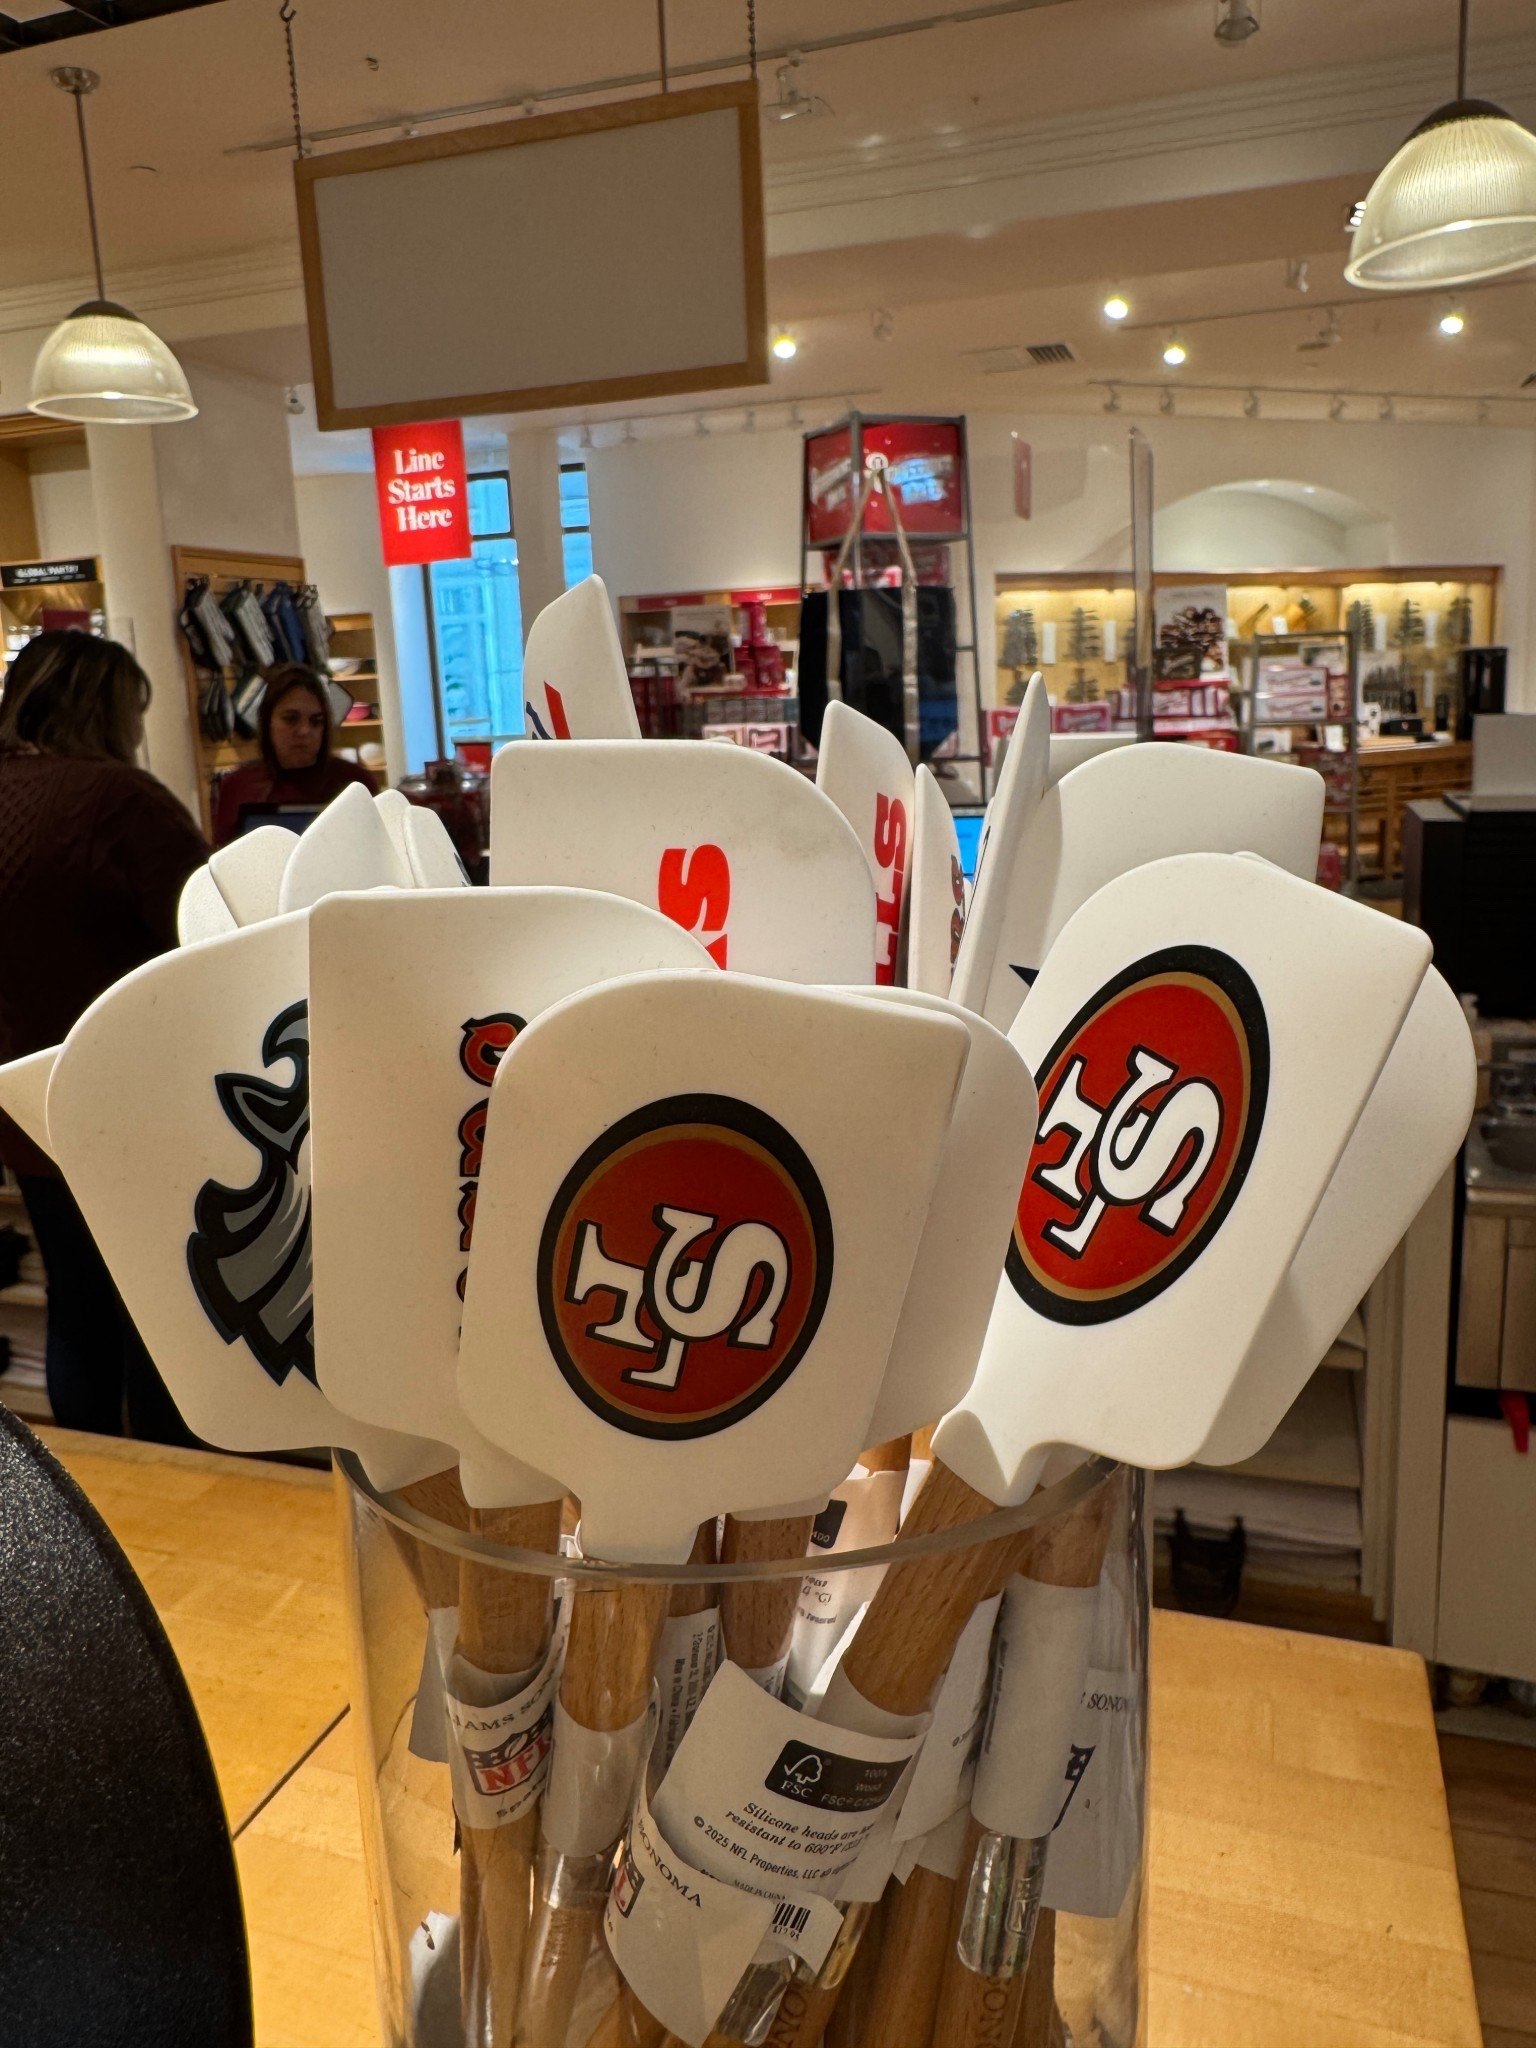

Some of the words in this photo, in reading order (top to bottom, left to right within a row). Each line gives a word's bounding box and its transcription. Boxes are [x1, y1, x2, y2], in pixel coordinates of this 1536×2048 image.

[393, 448, 445, 475] Line
[387, 476, 456, 505] Starts
[396, 505, 453, 532] Here
[780, 1779, 814, 1799] FSC
[725, 1810, 787, 1846] resistant
[787, 1838, 802, 1851] to
[743, 1802, 799, 1834] Silicone
[801, 1825, 839, 1841] heads
[704, 1825, 729, 1849] 2025
[729, 1842, 748, 1861] NFL
